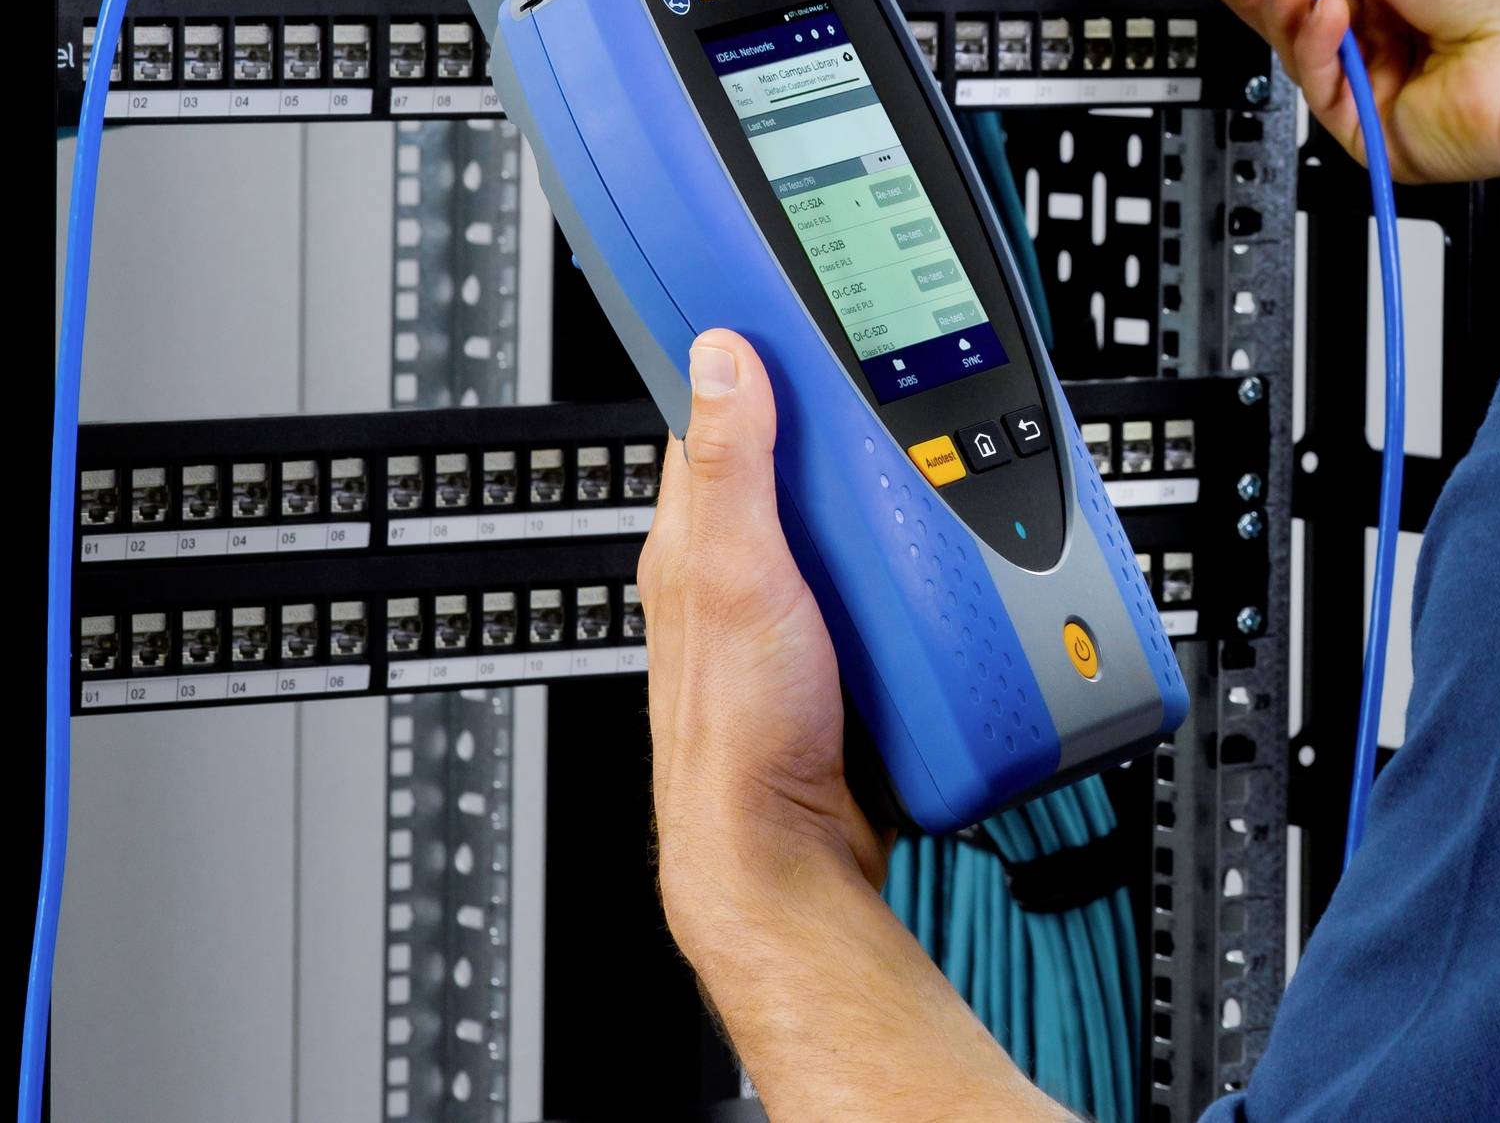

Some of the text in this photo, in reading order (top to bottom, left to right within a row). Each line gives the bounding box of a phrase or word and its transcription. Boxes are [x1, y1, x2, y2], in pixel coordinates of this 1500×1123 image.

[716, 42, 775, 64] IDEAL Networks
[758, 57, 839, 85] Main Campus Library
[732, 83, 743, 93] 76
[764, 73, 836, 97] Default Customer Name
[133, 94, 347, 109] 02 03 04 05 06
[736, 97, 753, 108] Tests
[747, 117, 776, 132] Last Test
[778, 183, 787, 194] All
[787, 179, 804, 191] Tests
[797, 219, 814, 231] Class
[819, 261, 835, 273] Class
[840, 304, 857, 316] Class
[861, 346, 878, 358] Class
[962, 354, 983, 368] SYNC
[897, 374, 918, 388] JOBS
[926, 451, 955, 469] Autotest
[130, 540, 146, 552] 02
[181, 538, 196, 550] 03
[232, 536, 246, 548] 04
[282, 533, 296, 544] 05
[331, 530, 345, 542] 06
[130, 688, 146, 700] 02
[180, 686, 196, 697] 03
[232, 682, 246, 694] 04
[281, 679, 296, 691] 05
[330, 676, 344, 688] 06
